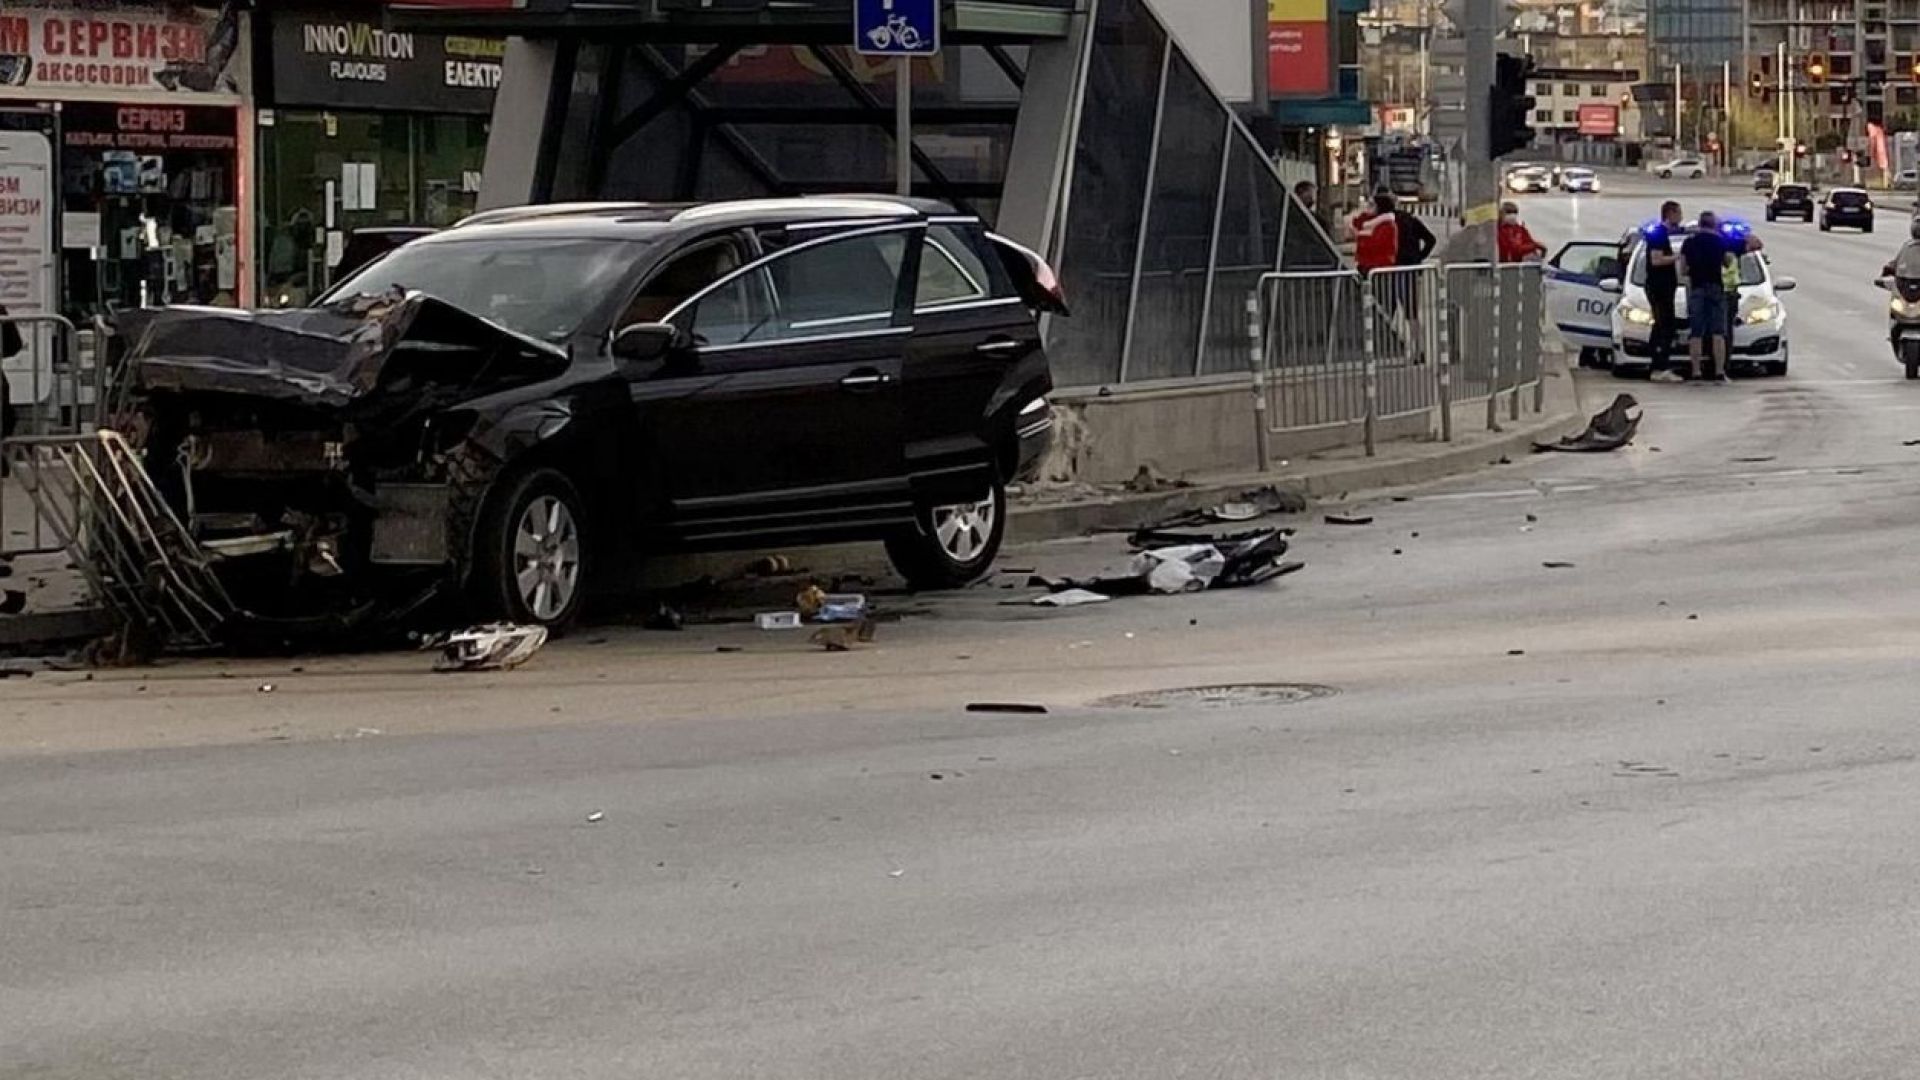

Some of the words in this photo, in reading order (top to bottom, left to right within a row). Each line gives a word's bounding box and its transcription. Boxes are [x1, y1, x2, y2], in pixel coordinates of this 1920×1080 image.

[304, 22, 414, 59] INNOVATION
[37, 61, 151, 86] аксесоари
[330, 61, 387, 82] FLAVOURS
[117, 107, 186, 131] СЕРВИЗ
